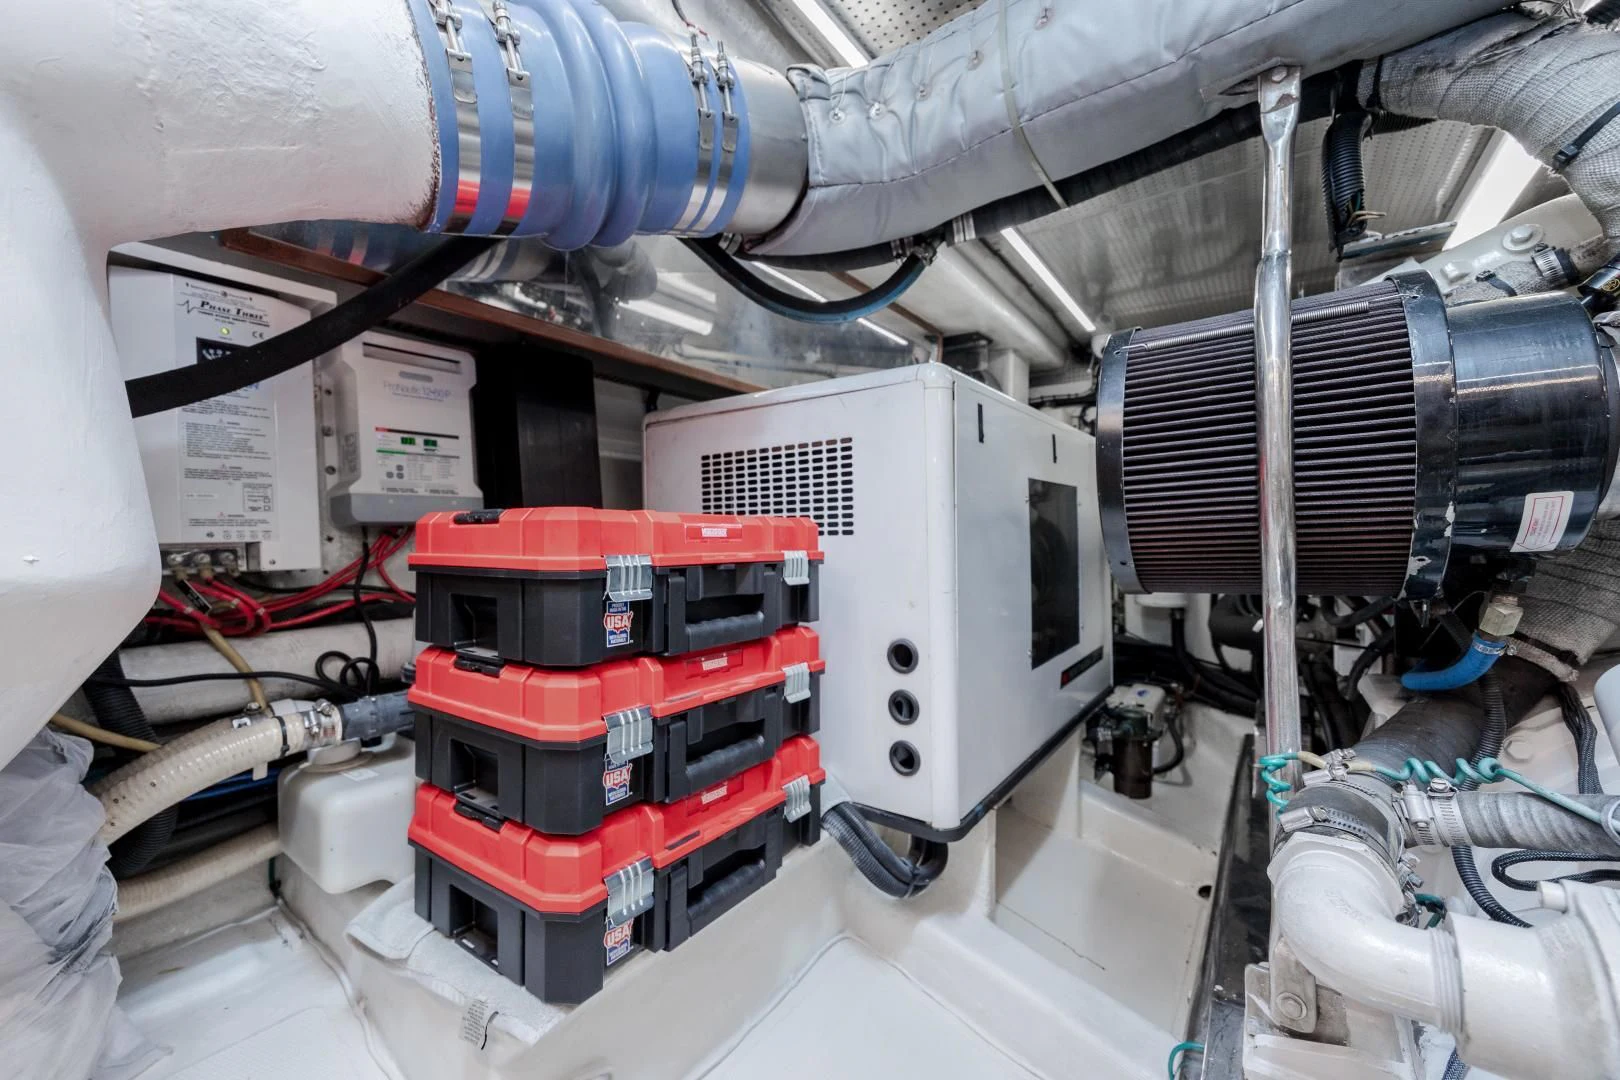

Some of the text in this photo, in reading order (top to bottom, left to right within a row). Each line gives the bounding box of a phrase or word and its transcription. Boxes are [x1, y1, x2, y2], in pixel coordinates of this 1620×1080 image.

[606, 614, 629, 629] USA
[605, 768, 629, 787] USA
[606, 924, 630, 947] USA
